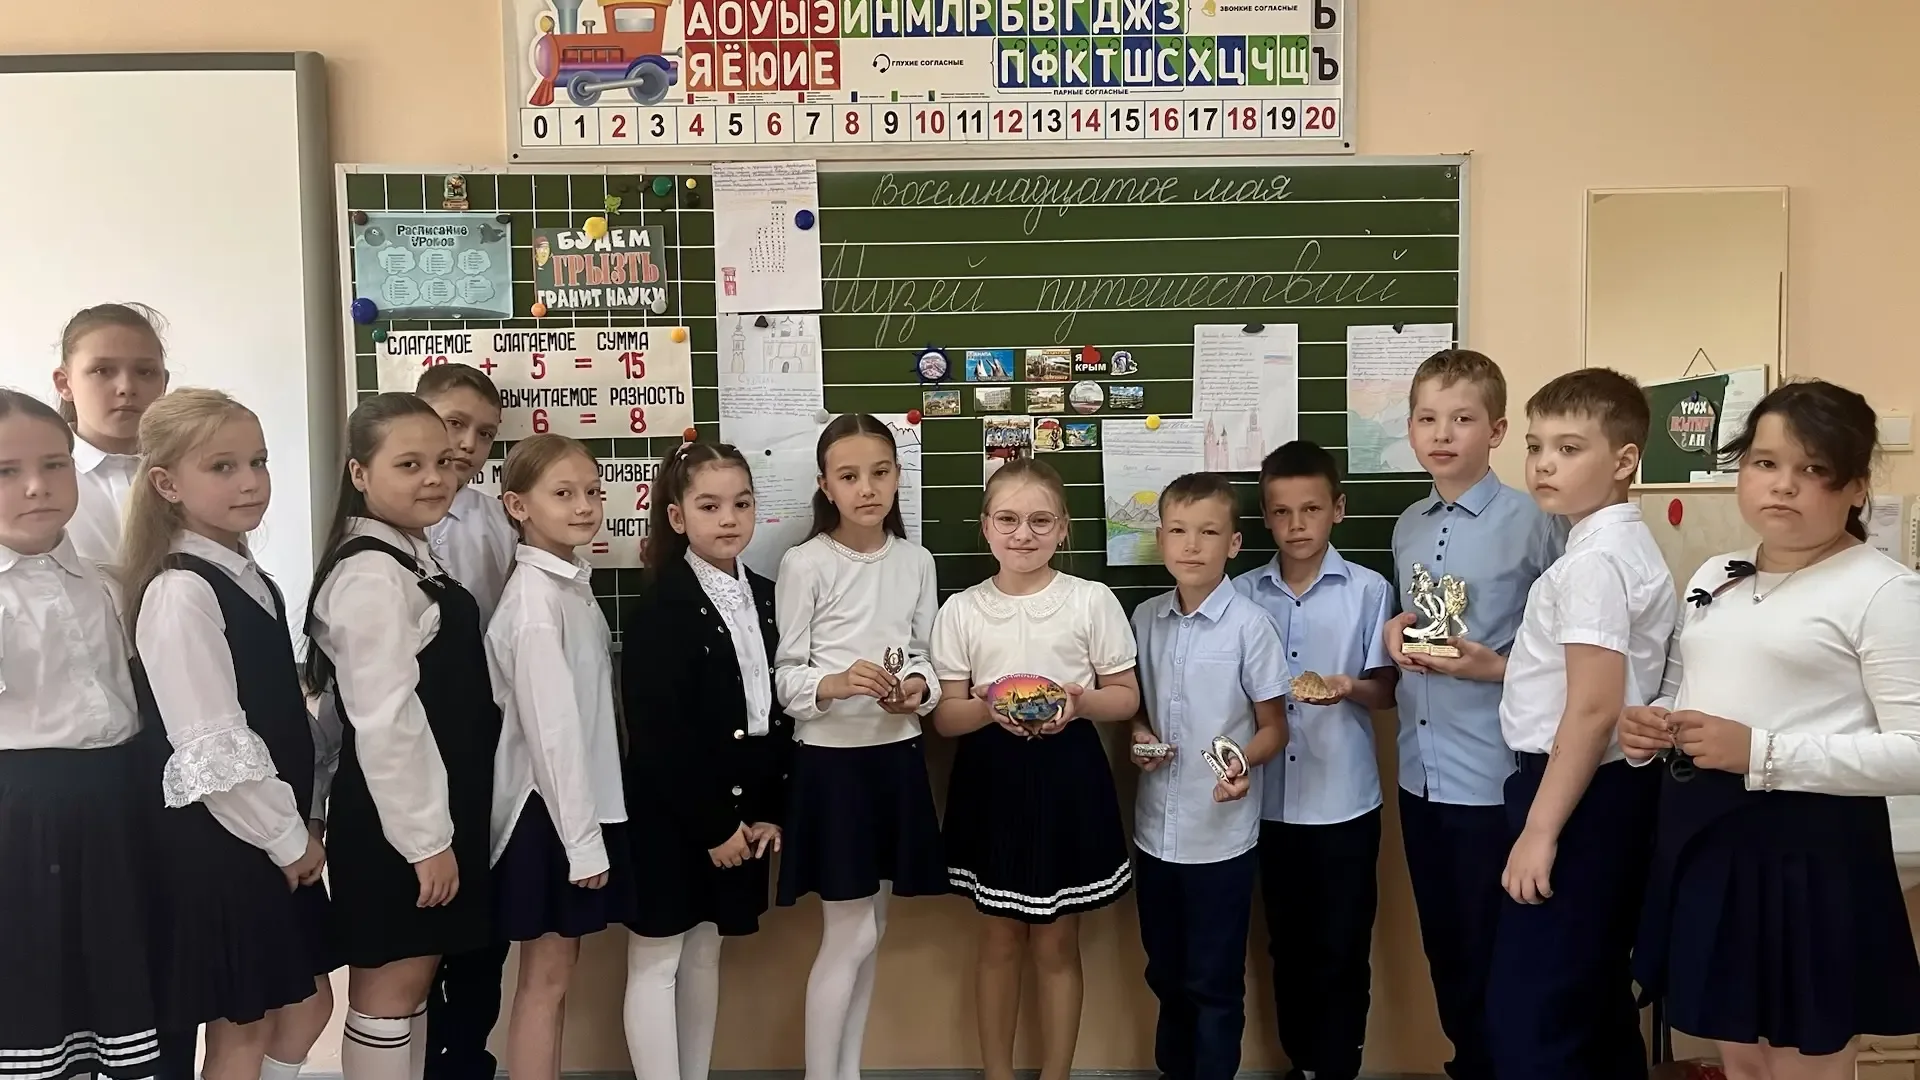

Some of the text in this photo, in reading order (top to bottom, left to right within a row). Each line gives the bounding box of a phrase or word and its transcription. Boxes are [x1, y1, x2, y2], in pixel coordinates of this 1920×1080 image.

[1254, 4, 1299, 12] СОГЛАСНЫЕ
[533, 106, 1336, 139] 0 1 2 3 4 5 6 7 8 9 10 11 12 13 14 15 16 17 18 19 20
[871, 173, 1293, 235] Восемнадцатое мая
[552, 252, 660, 287] ГРЫЗТЬ
[537, 286, 665, 308] ГРАНИТ НАУКИ
[823, 239, 1408, 348] Музей путешествий
[387, 331, 649, 355] СЛАГАЕМОЕ СЛАГАЕМОЕ СУММА
[530, 353, 546, 380] 5
[618, 352, 646, 379] 15
[1074, 354, 1082, 362] Я
[1075, 363, 1106, 371] КРЫМ
[500, 386, 685, 408] ВЫЧИТАЕМОЕ РАЗНОСТЬ
[532, 408, 549, 434] 6
[630, 407, 647, 433] 8
